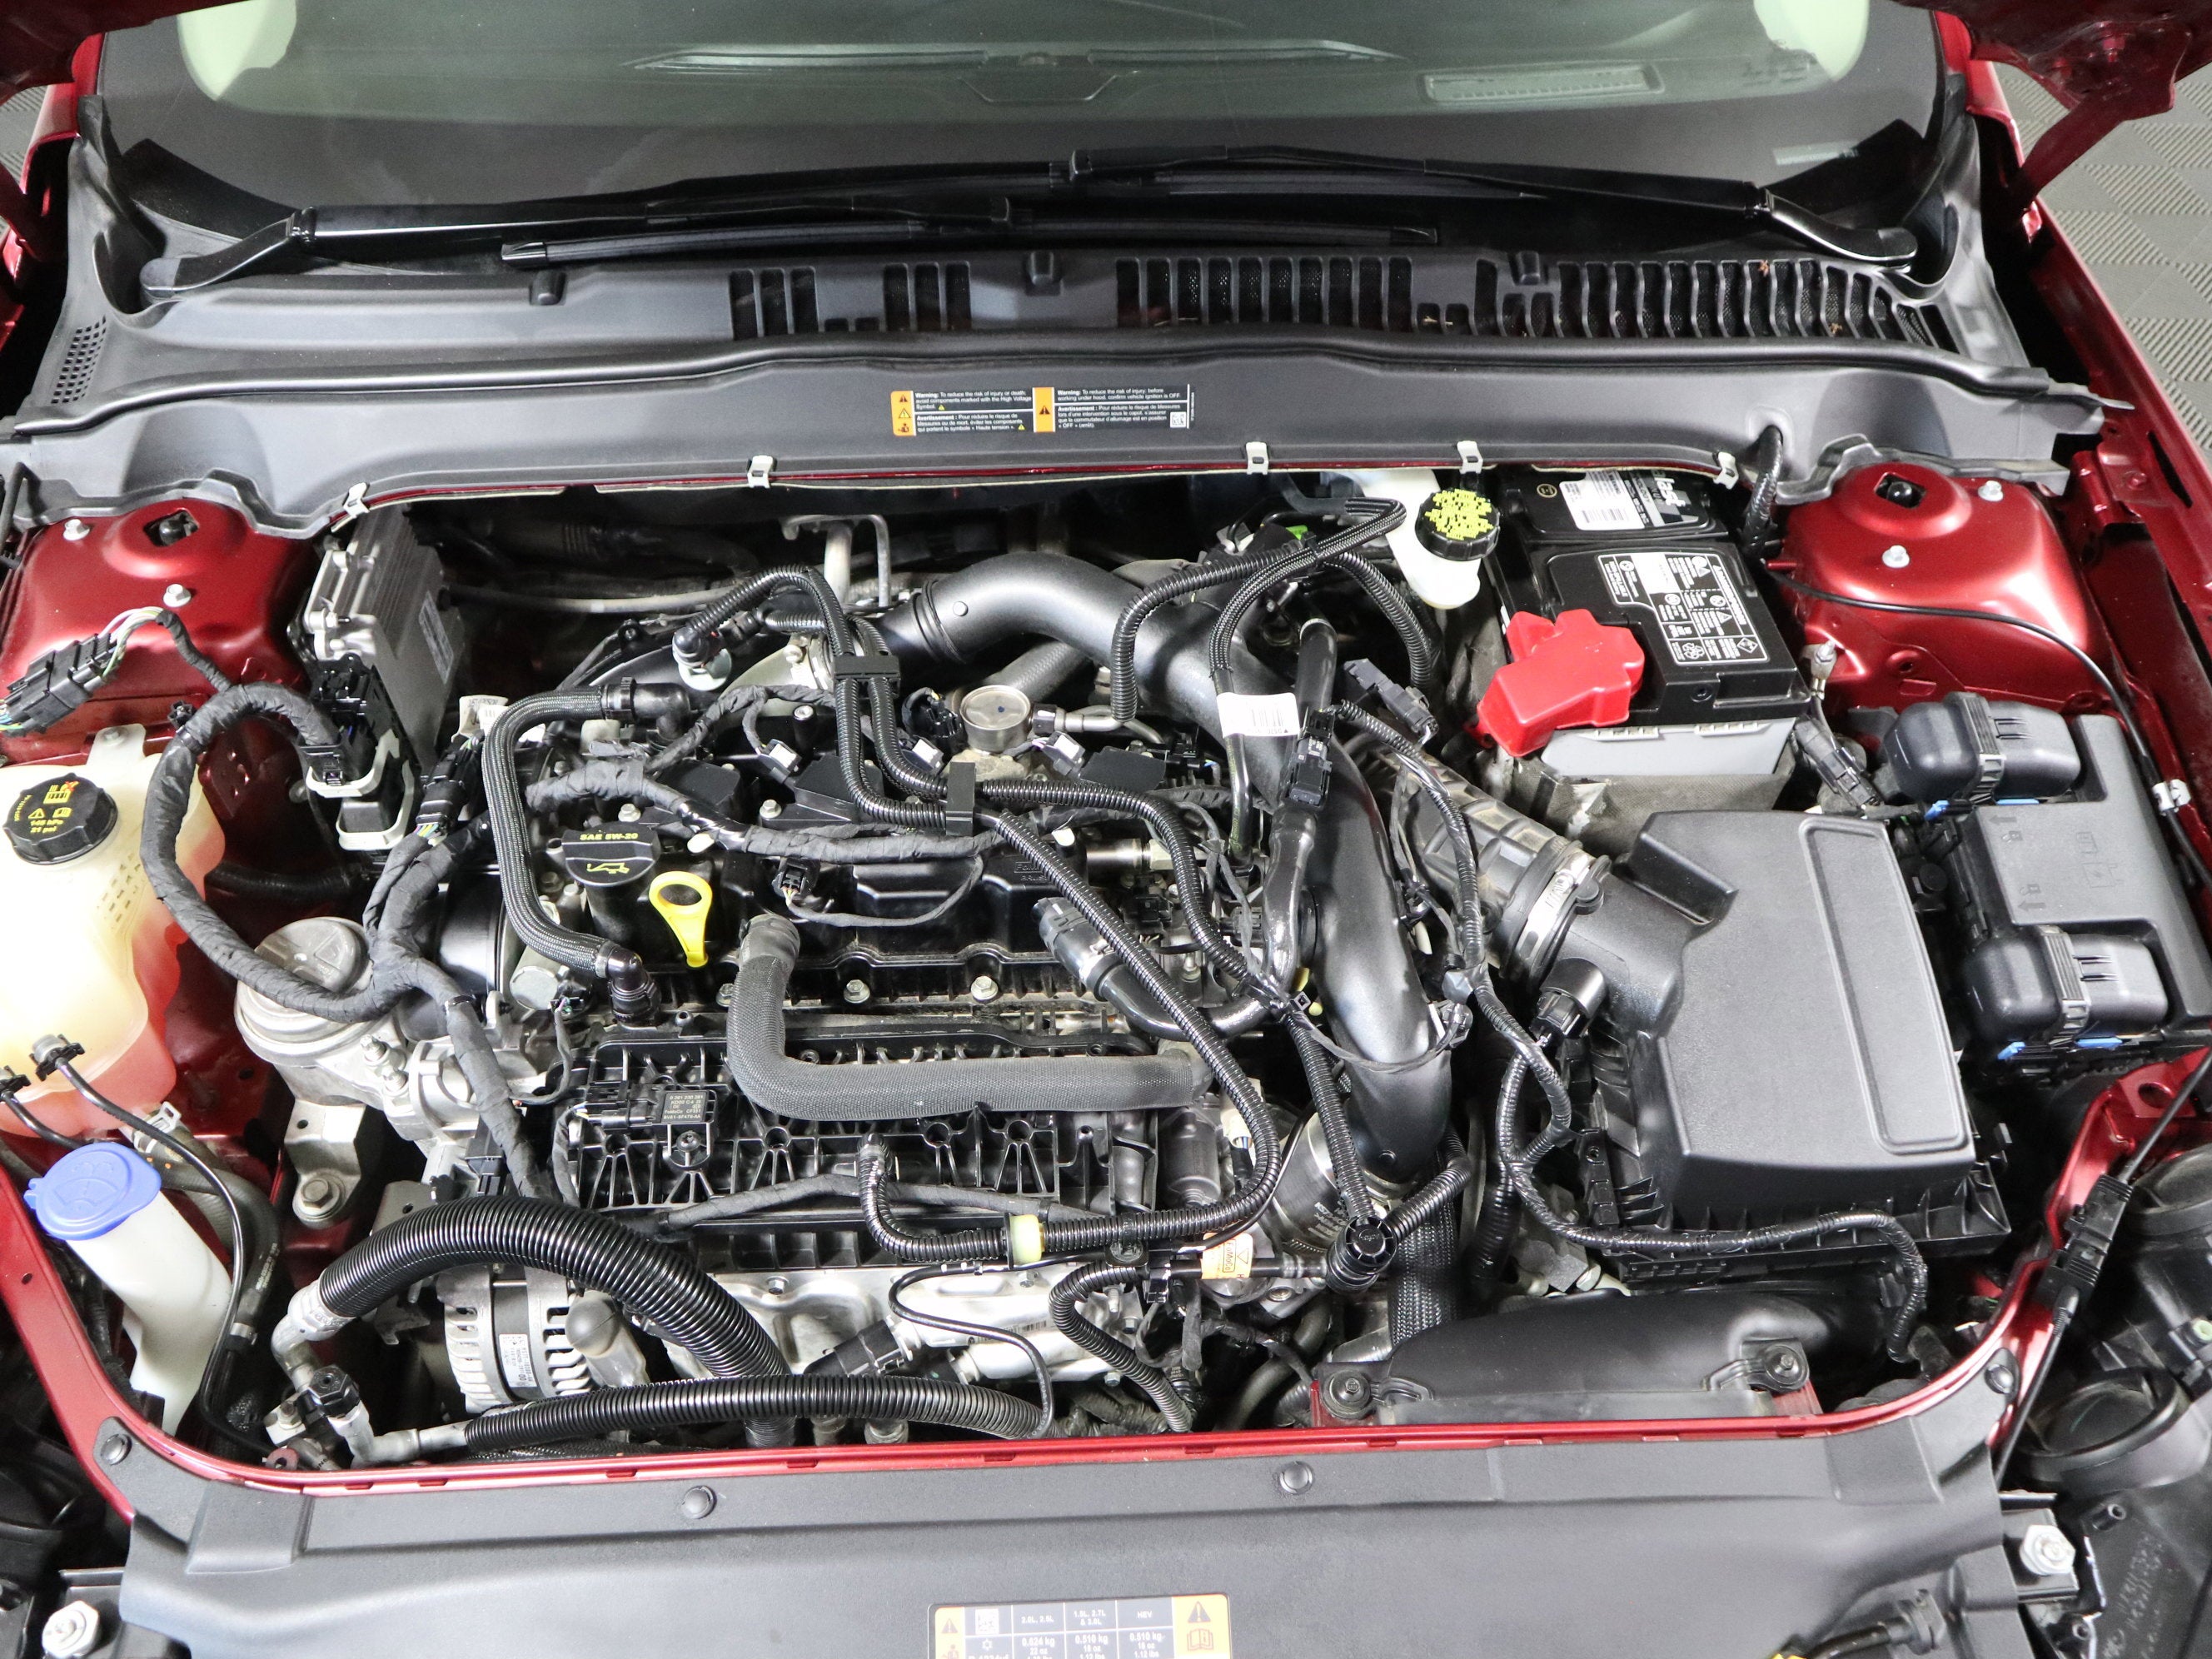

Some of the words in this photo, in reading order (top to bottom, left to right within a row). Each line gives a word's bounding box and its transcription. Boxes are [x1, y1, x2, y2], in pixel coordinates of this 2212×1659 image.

[1044, 1637, 1055, 1647] kg
[1098, 1634, 1108, 1644] kg
[1152, 1632, 1162, 1642] kg
